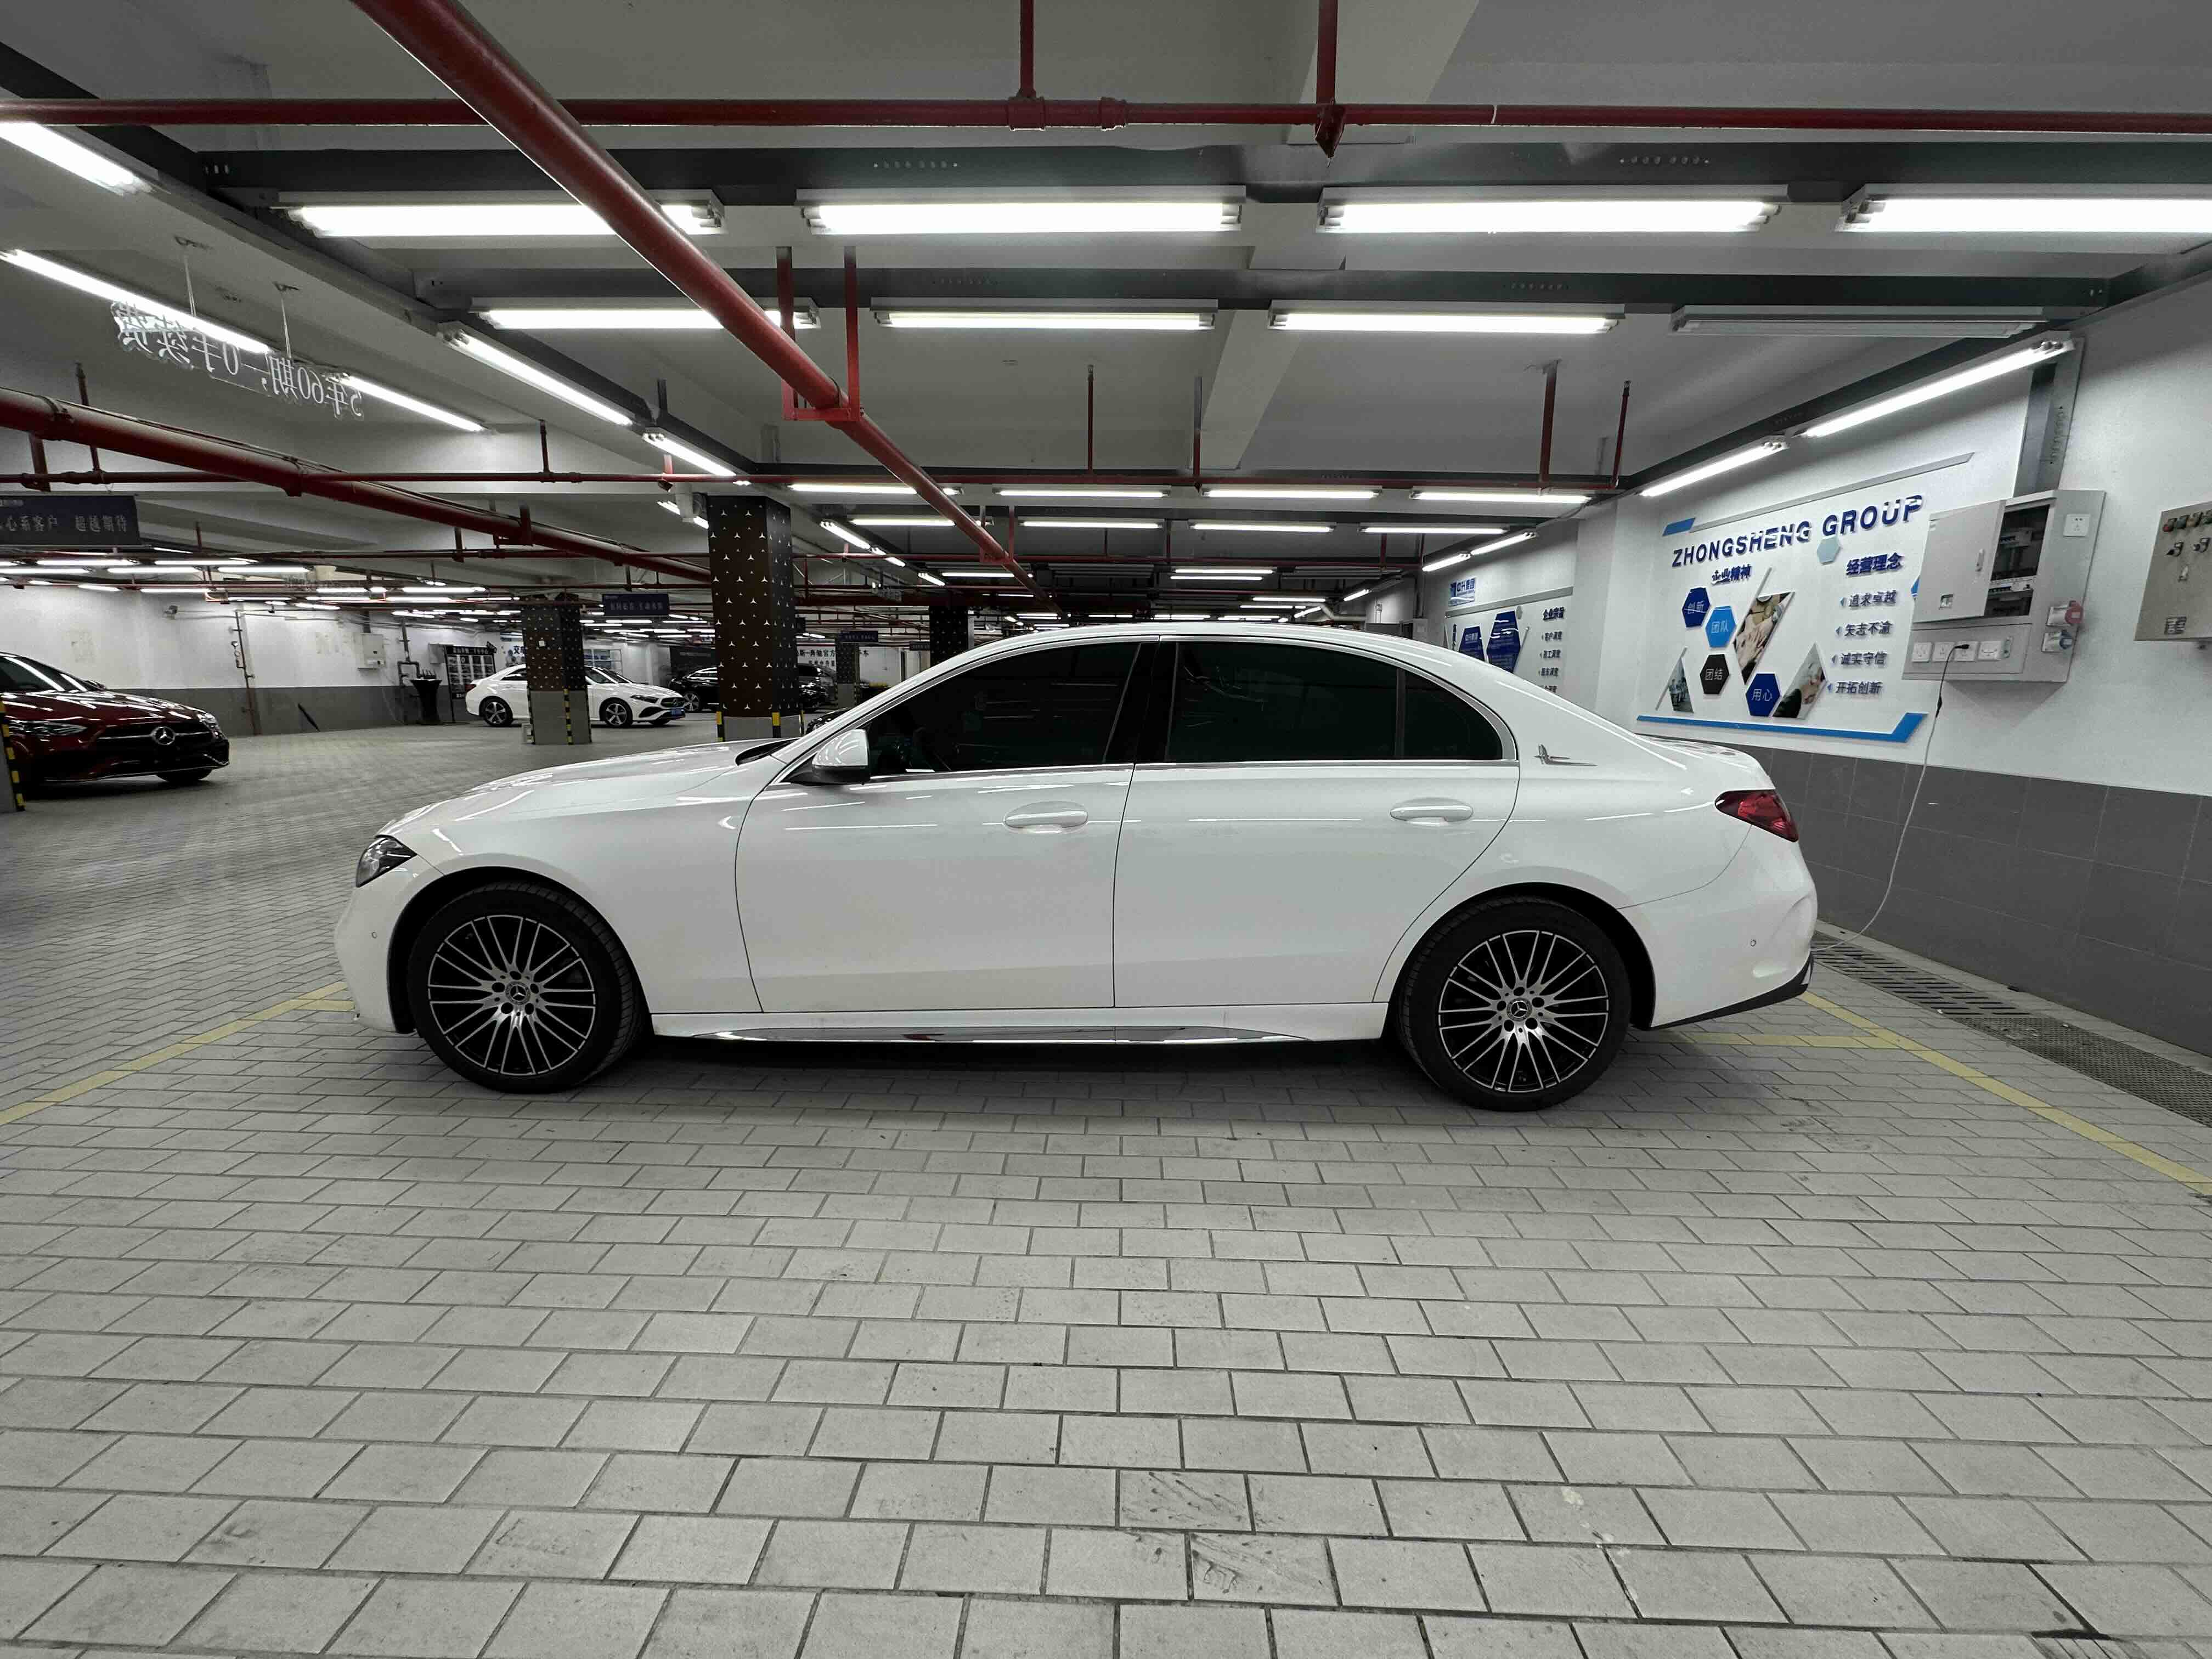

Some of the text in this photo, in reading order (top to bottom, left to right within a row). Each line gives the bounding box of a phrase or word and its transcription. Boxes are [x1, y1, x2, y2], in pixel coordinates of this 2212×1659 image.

[1672, 495, 1923, 567] ZHONGSHENG GROUP
[1846, 552, 1904, 576] 经营理念
[1711, 563, 1752, 585] 企业精神
[1848, 590, 1897, 607] 追求卓越
[1711, 619, 1729, 633] 团队
[1844, 620, 1892, 636] 矢志不渝
[1840, 651, 1887, 665] 诚实守信
[1705, 668, 1723, 681] 团结
[1751, 689, 1773, 702] 用心
[1836, 681, 1883, 695] 开拓创新
